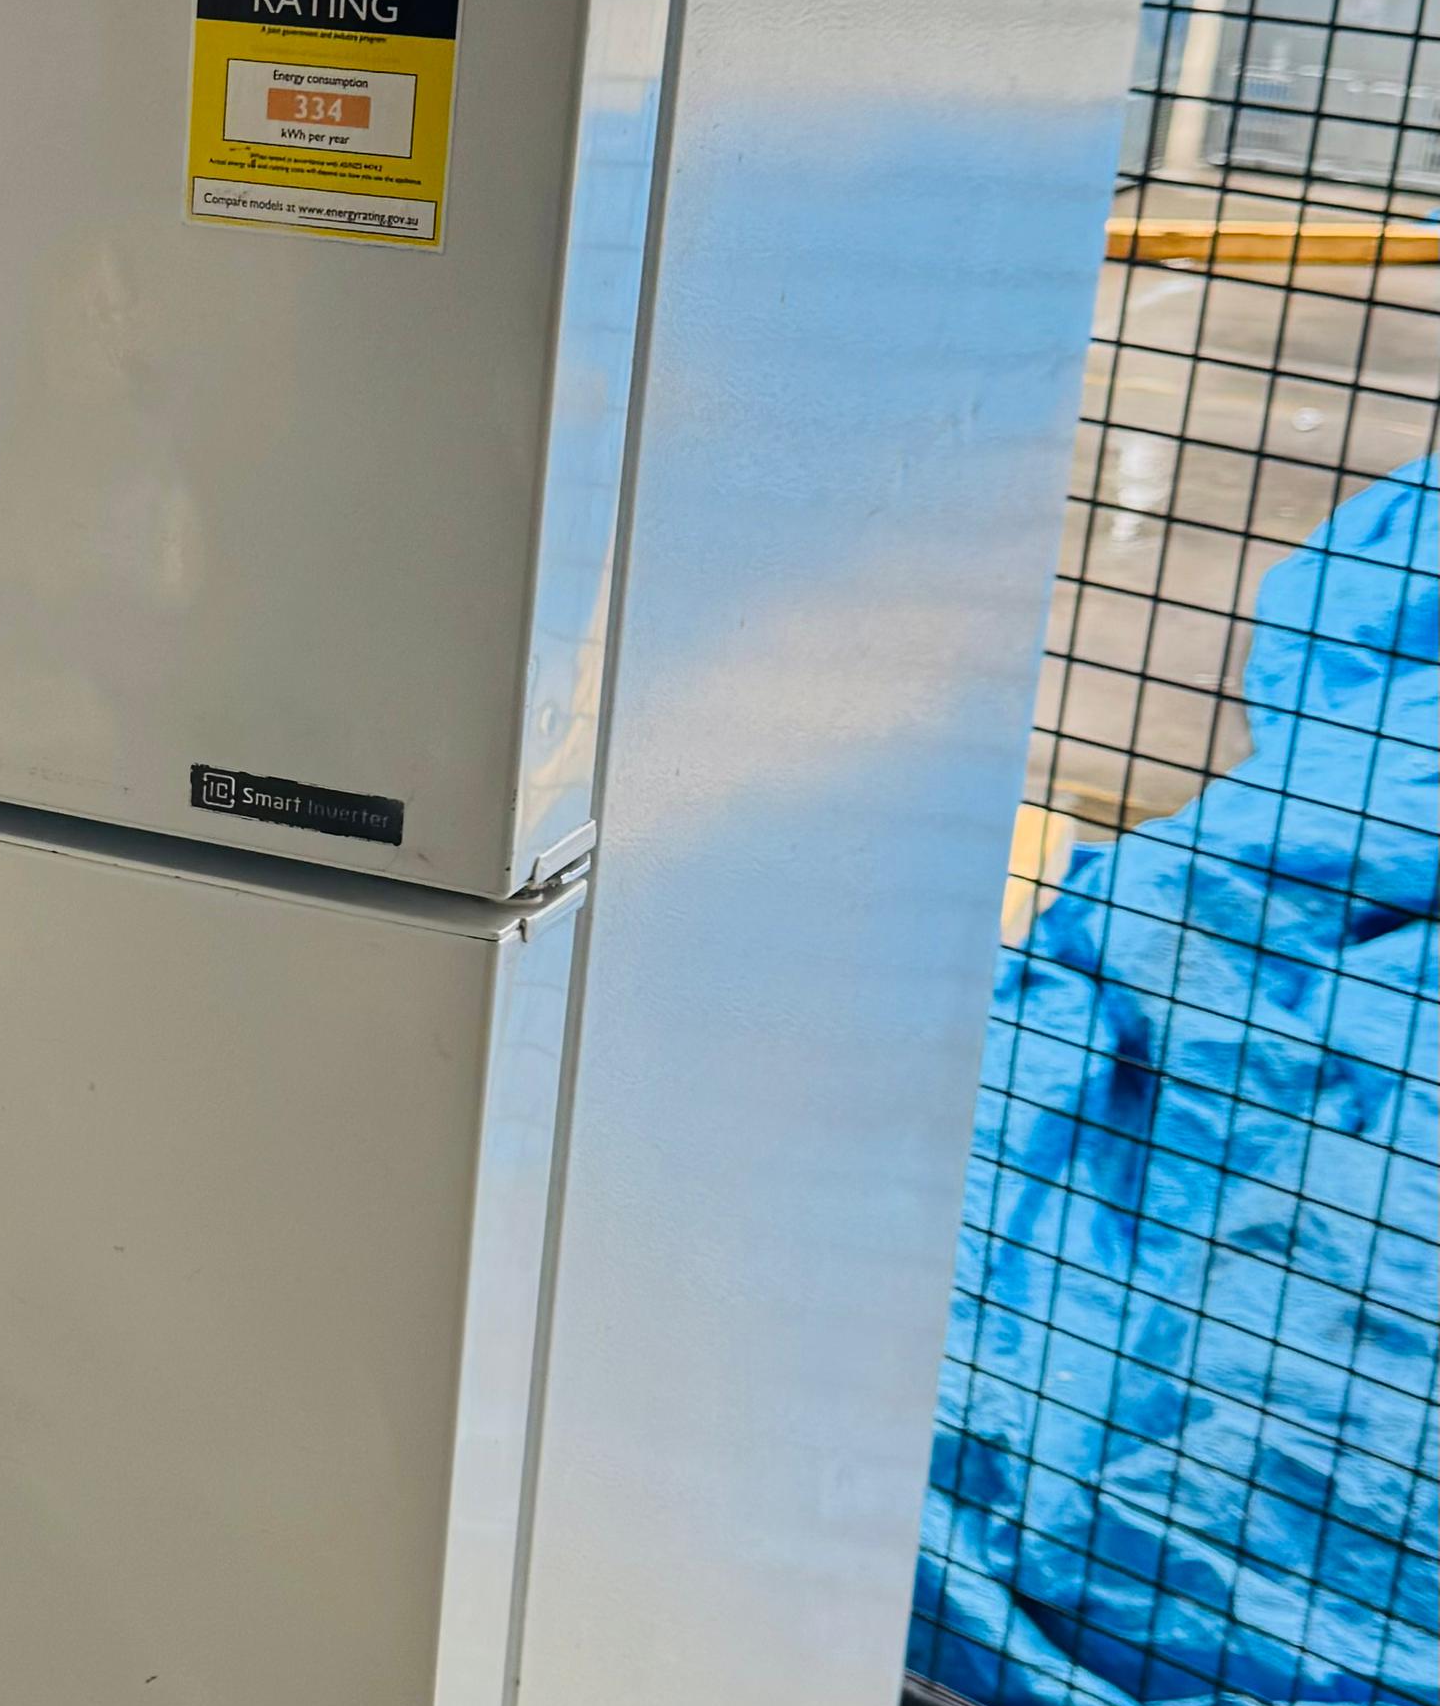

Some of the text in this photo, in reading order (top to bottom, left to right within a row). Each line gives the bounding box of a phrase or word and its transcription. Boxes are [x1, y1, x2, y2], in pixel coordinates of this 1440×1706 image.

[273, 69, 369, 89] Energy consumption
[294, 94, 343, 122] 334
[280, 128, 350, 145] kWh per year
[204, 192, 419, 227] Compare models at www.energyrating.gov.au
[242, 787, 303, 814] Smart
[307, 800, 390, 829] Inverter
